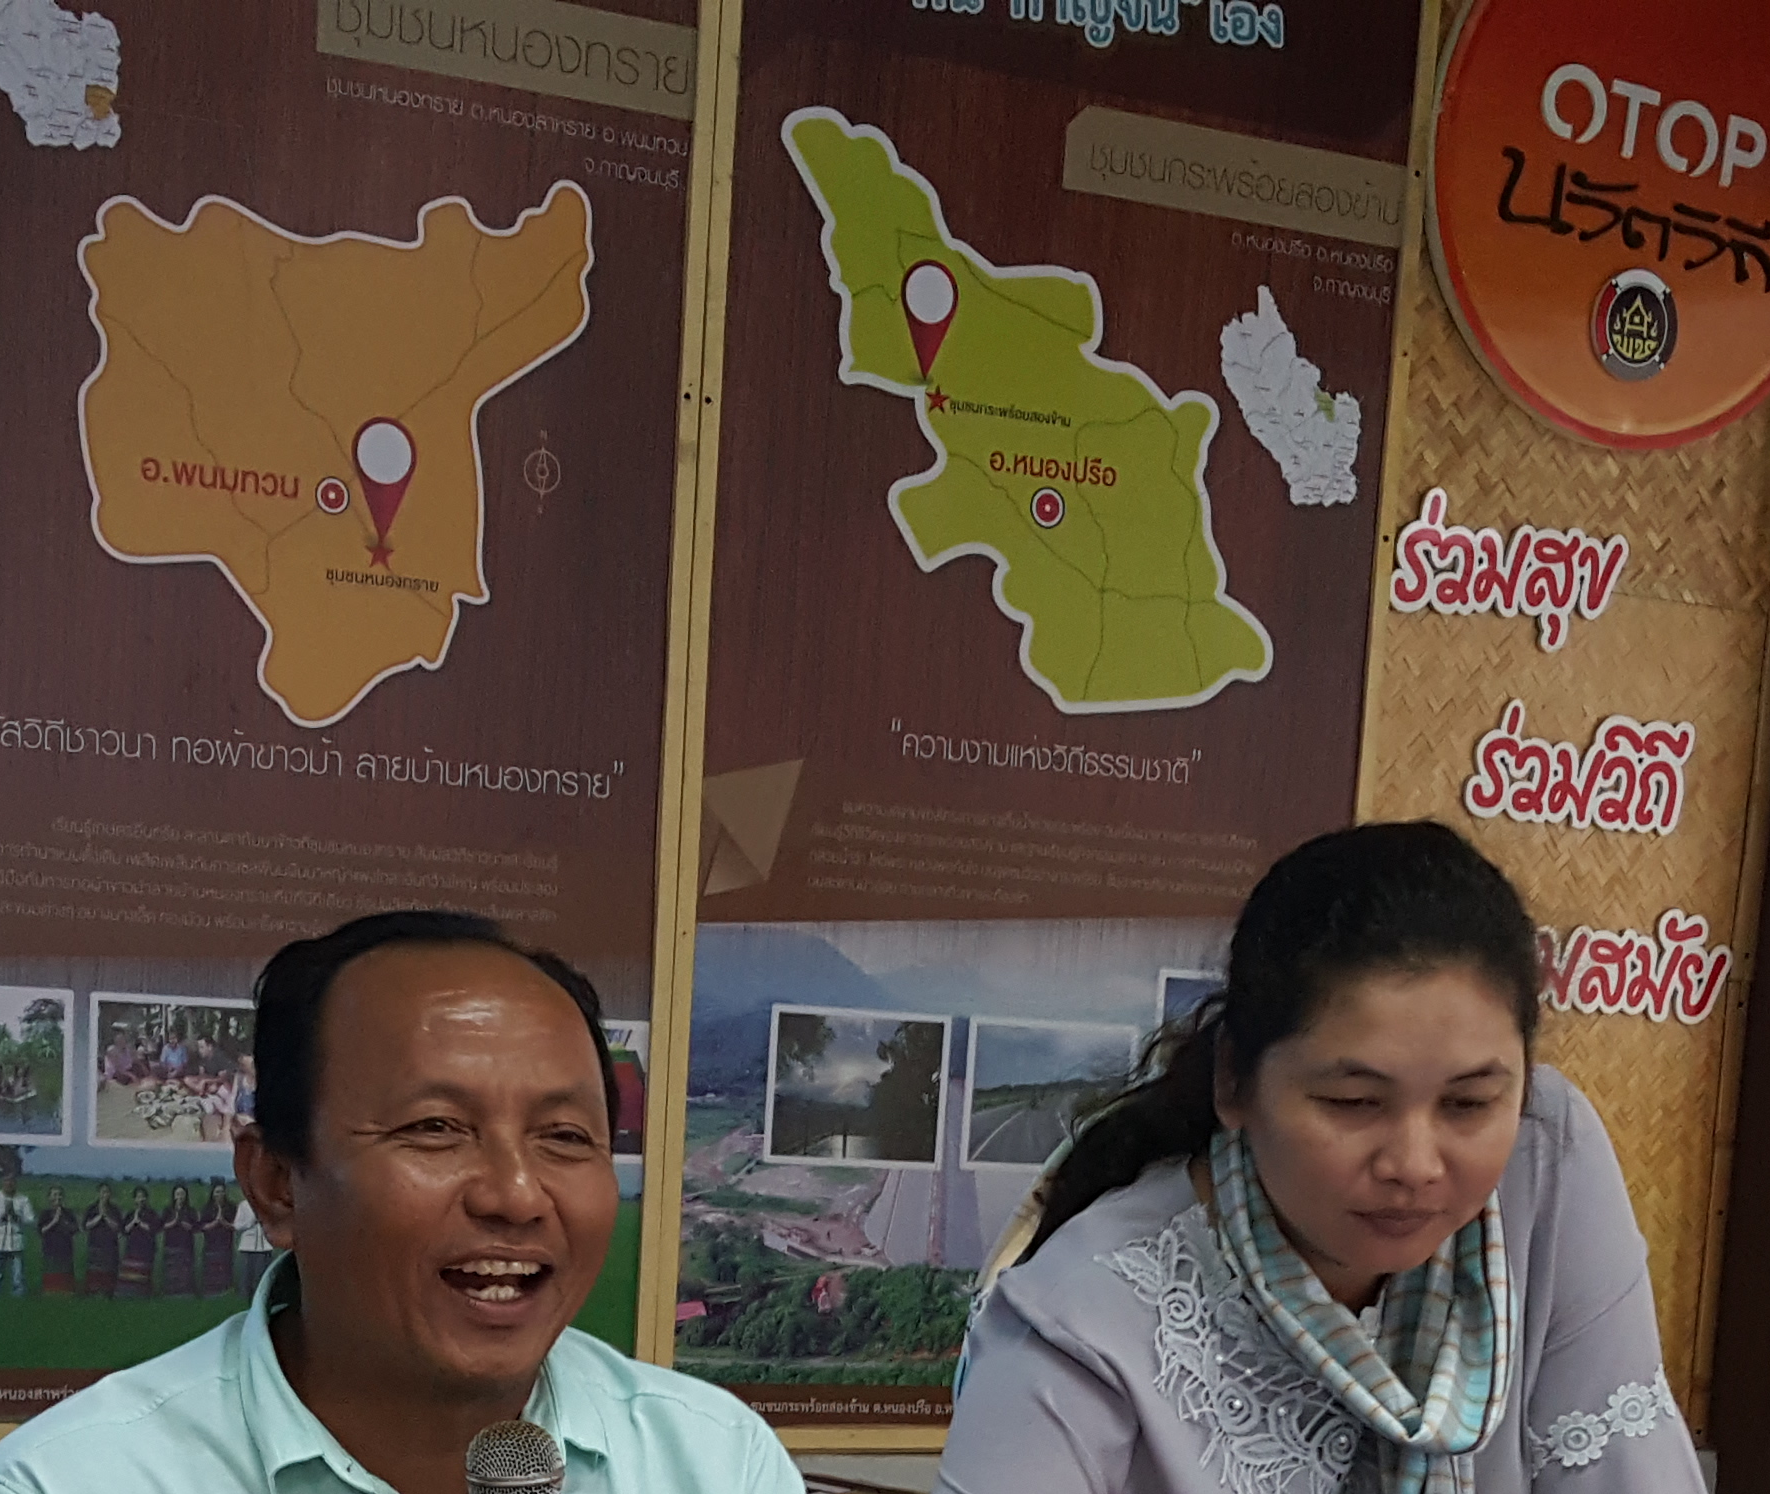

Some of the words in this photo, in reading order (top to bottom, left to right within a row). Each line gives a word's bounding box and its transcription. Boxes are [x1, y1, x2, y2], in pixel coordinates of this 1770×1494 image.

[1541, 63, 1768, 187] OTOP
[139, 454, 301, 502] อ.พนมทวน
[990, 451, 1117, 487] อ.หนองปรือ
[1392, 488, 1627, 650] ร่วมสุข
[171, 730, 344, 780] ทอผ้าขาวม้า
[1468, 700, 1694, 832] ร่วมวิถี
[1534, 909, 1731, 1023] มสมัย
